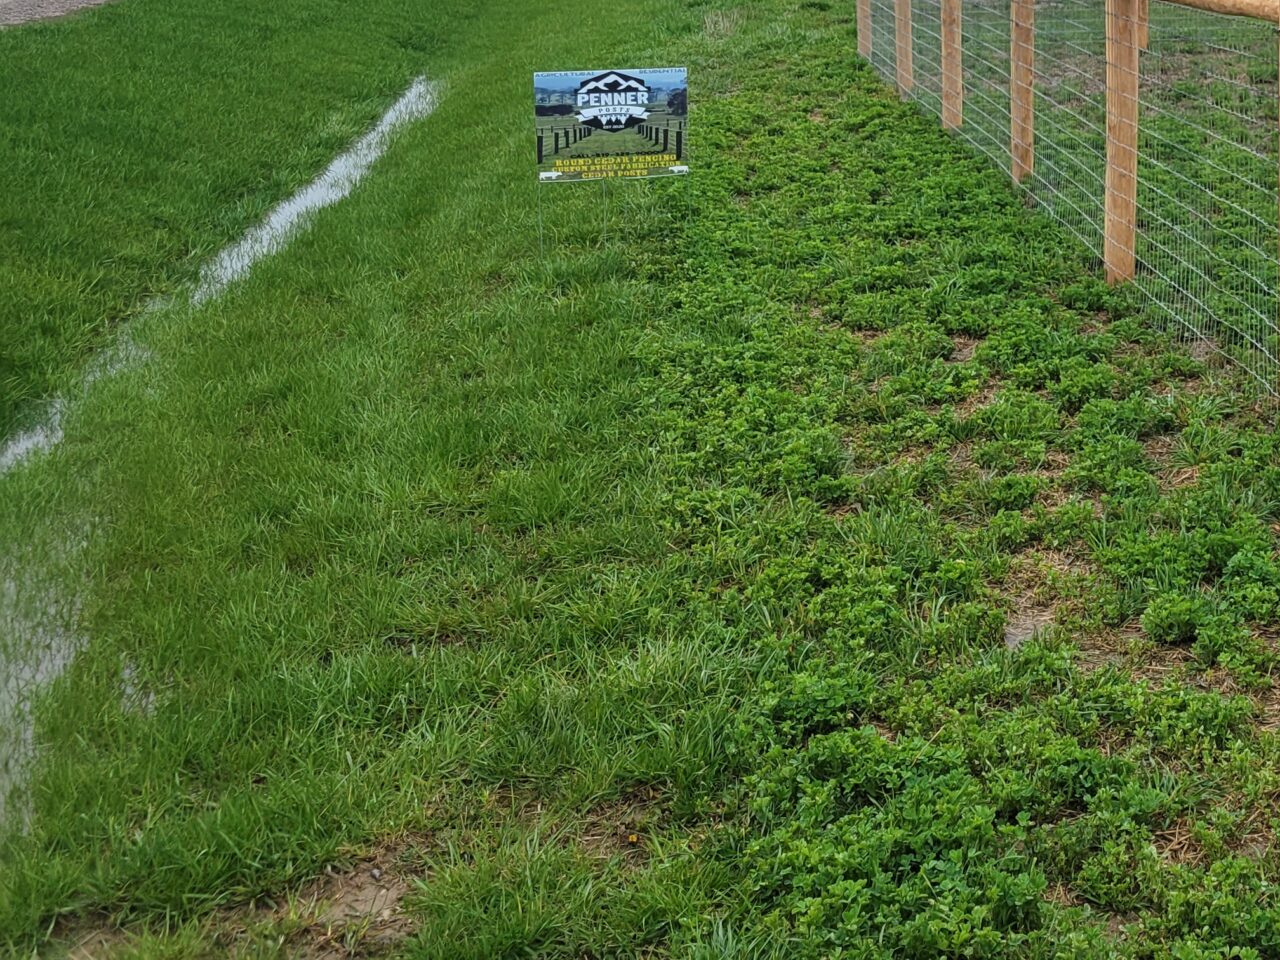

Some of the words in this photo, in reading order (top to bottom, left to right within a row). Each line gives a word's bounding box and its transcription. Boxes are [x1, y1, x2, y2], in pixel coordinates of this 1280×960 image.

[577, 91, 649, 107] PENNER
[555, 158, 592, 167] ROUND
[594, 156, 630, 165] CEDAR
[632, 154, 677, 163] FENCING
[552, 165, 588, 173] CUSTOM
[620, 161, 681, 170] FABRICATION
[581, 170, 615, 179] CEDAR
[617, 169, 648, 177] POSTS
